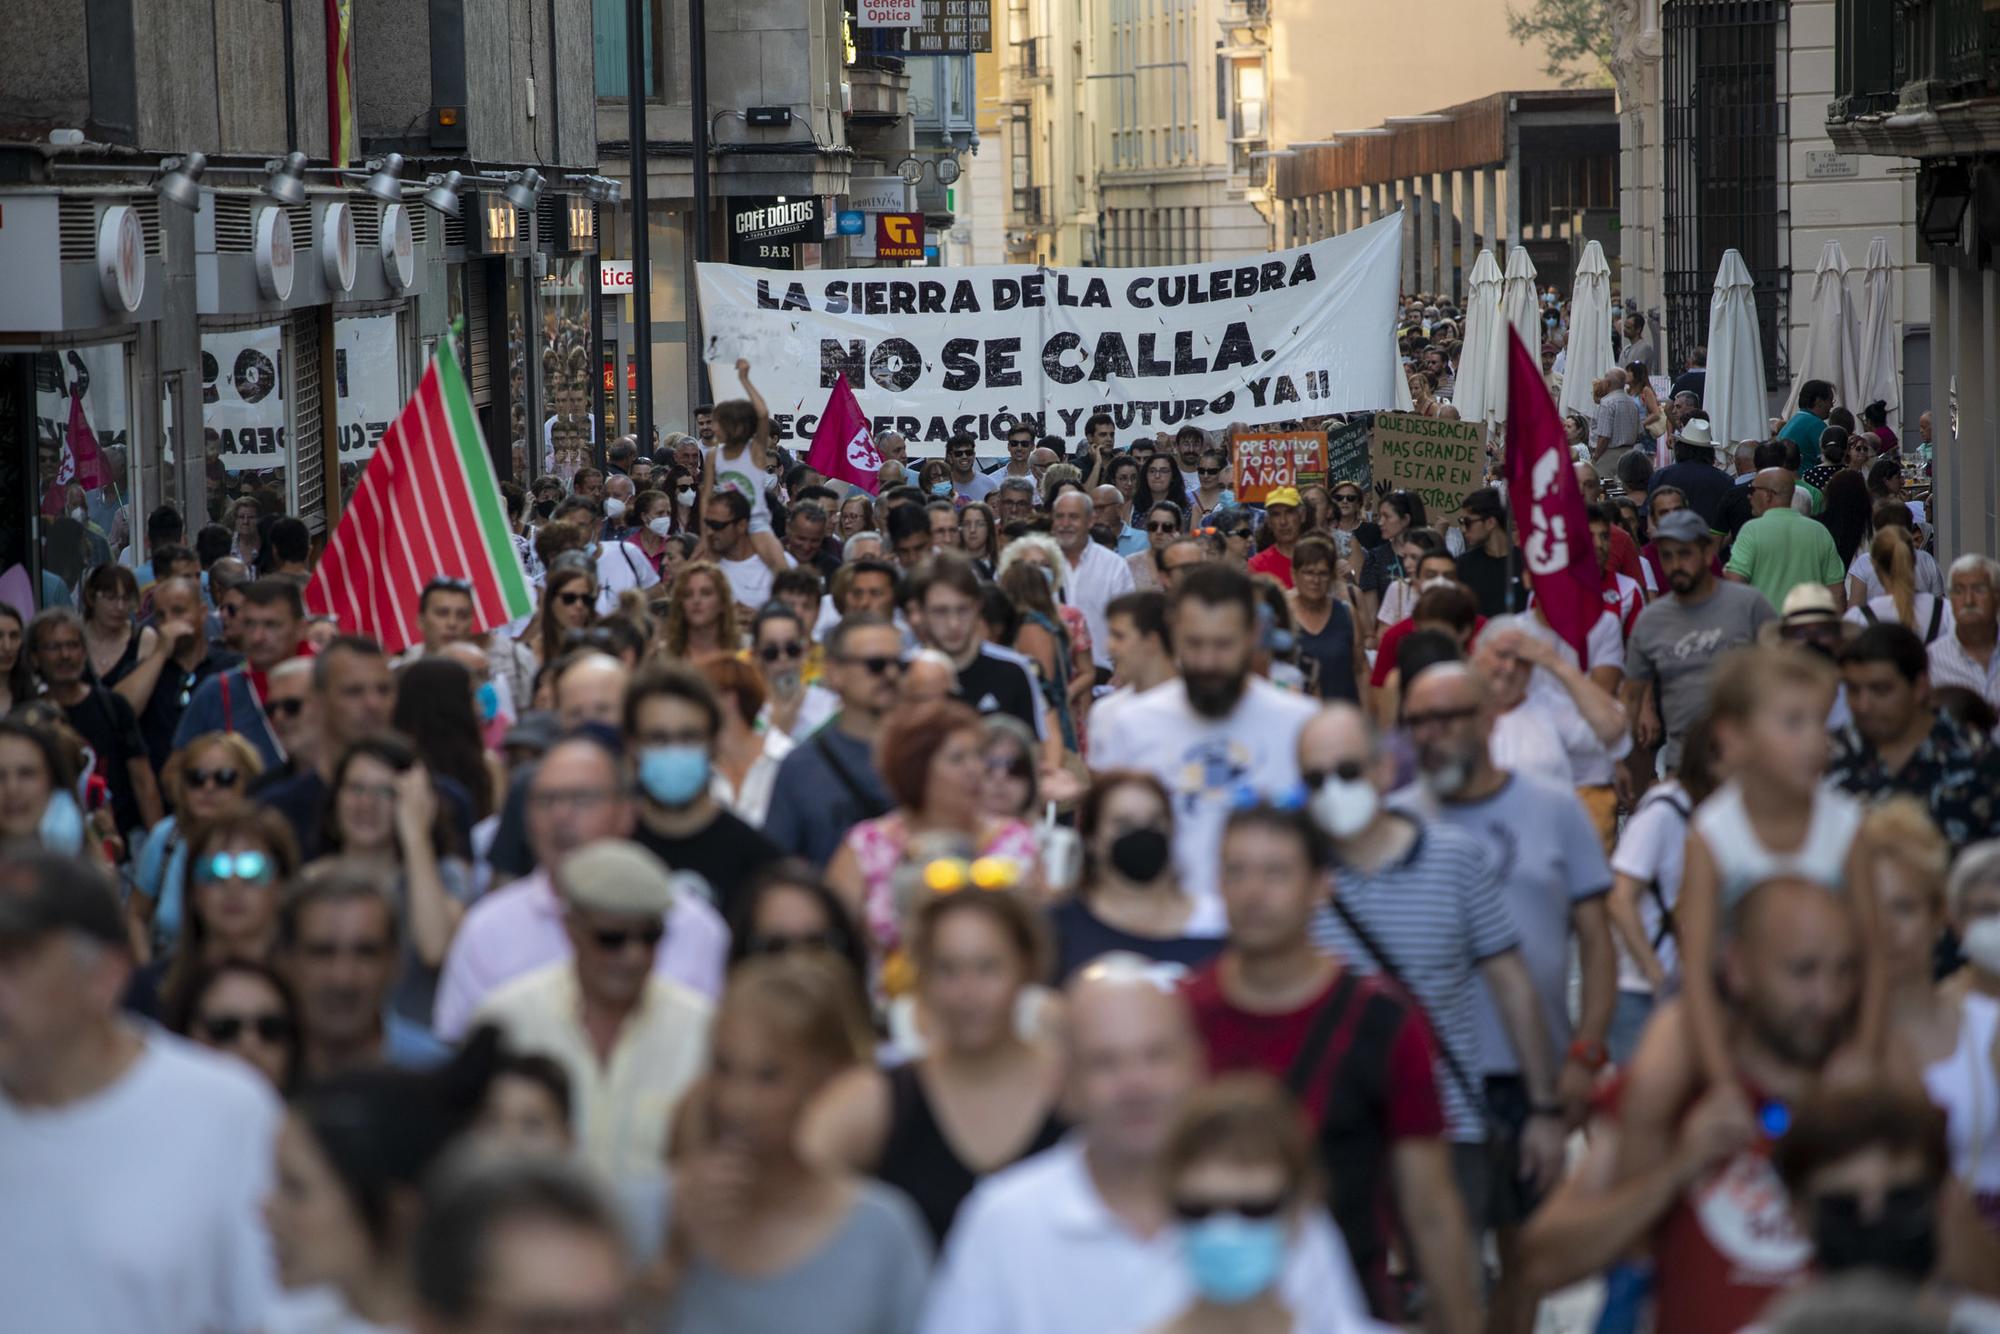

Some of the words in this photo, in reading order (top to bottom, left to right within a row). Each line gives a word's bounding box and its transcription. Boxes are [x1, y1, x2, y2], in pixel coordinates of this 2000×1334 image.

[867, 9, 911, 23] Optica
[920, 1, 941, 15] NTRO
[946, 1, 989, 15] ENSEANZA
[944, 18, 989, 32] CONFECION
[949, 35, 982, 50] ANGEES
[767, 200, 814, 228] DOLFOS
[760, 245, 791, 258] BAR
[880, 248, 922, 257] TABACOS
[602, 267, 634, 286] tica
[757, 279, 812, 312] LA
[824, 280, 981, 315] SIERRA
[993, 274, 1045, 311] DE
[1058, 274, 1112, 308] LA
[1126, 253, 1317, 309] CULEBRA
[820, 338, 922, 393] NO
[941, 337, 1023, 392] SE
[1041, 321, 1277, 385] CALLA.
[774, 406, 1046, 443] ECERACIÓN
[1057, 408, 1084, 437] Y
[1245, 370, 1331, 408] YA!!
[1378, 415, 1404, 432] QUE
[1405, 419, 1479, 441] DESGRACIA
[1240, 455, 1287, 469] TODO
[1293, 453, 1317, 465] EL
[1382, 440, 1410, 458] MAS
[1412, 441, 1478, 464] GRANDE
[1241, 467, 1298, 488] AÑO!
[1394, 461, 1447, 483] ESTAR
[1450, 467, 1473, 486] EN
[1414, 488, 1465, 515] STRAS
